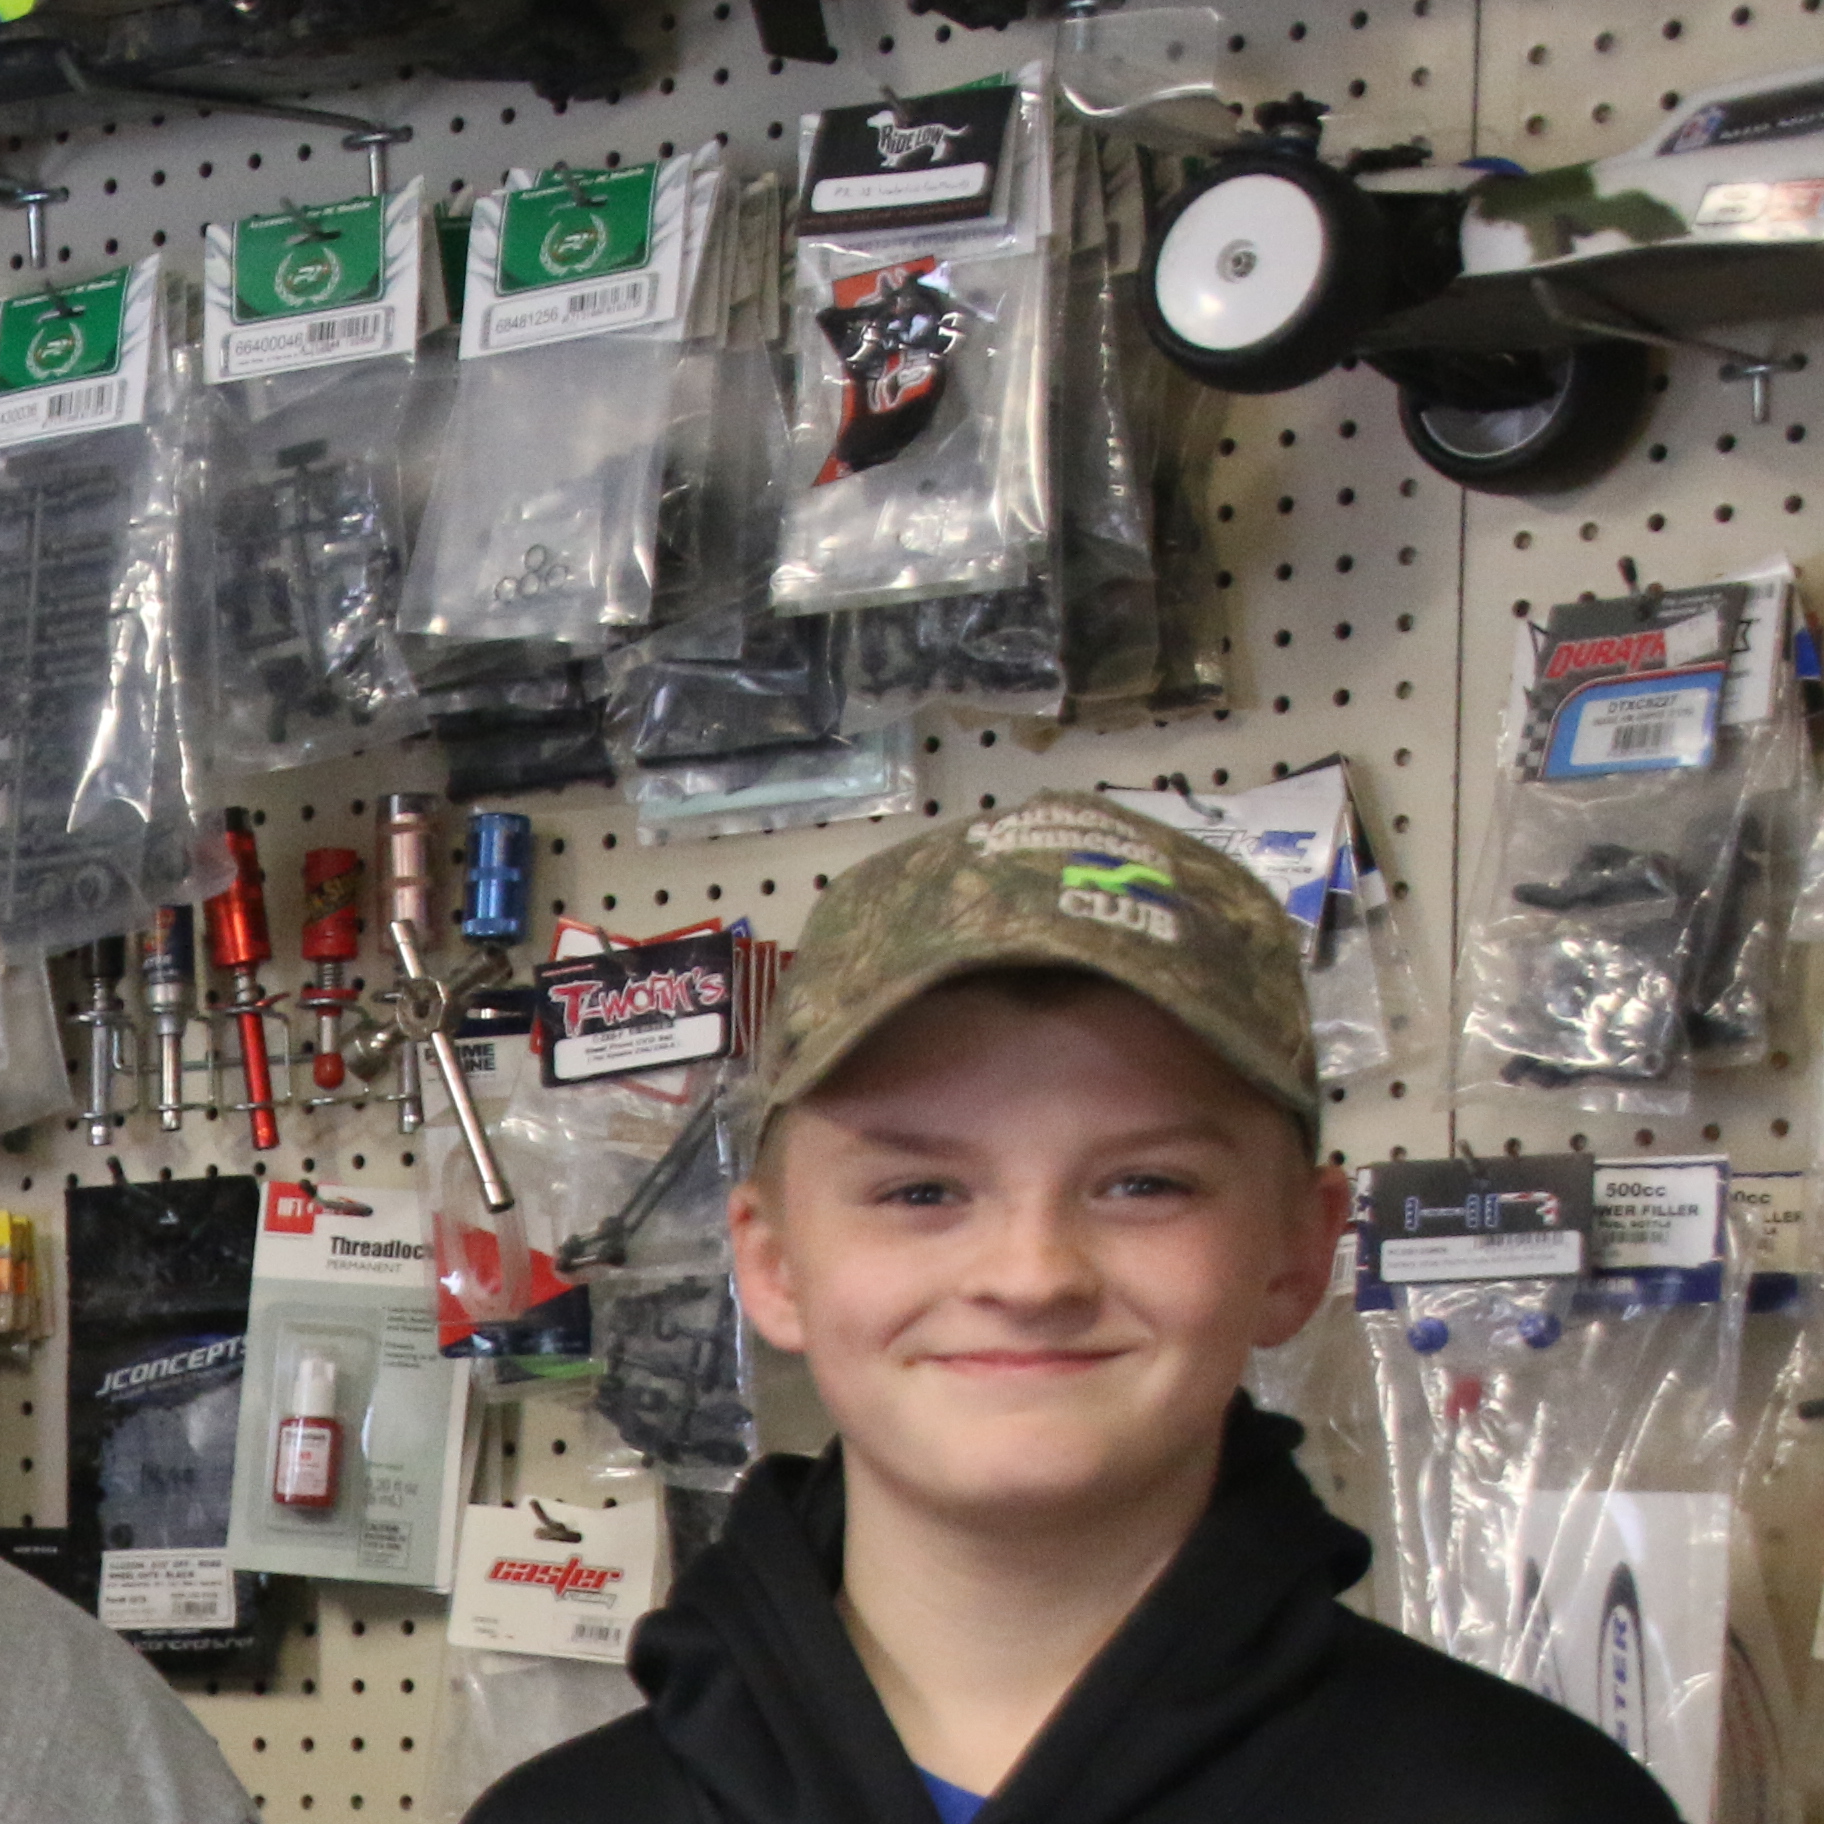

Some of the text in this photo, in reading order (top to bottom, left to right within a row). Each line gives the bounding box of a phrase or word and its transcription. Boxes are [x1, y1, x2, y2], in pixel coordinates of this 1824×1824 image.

[1058, 889, 1180, 942] CLUB
[1605, 1183, 1666, 1198] 500cc
[1594, 1204, 1700, 1218] WER FILLER
[328, 1259, 403, 1275] PERMANENT
[1613, 1614, 1628, 1750] STER
